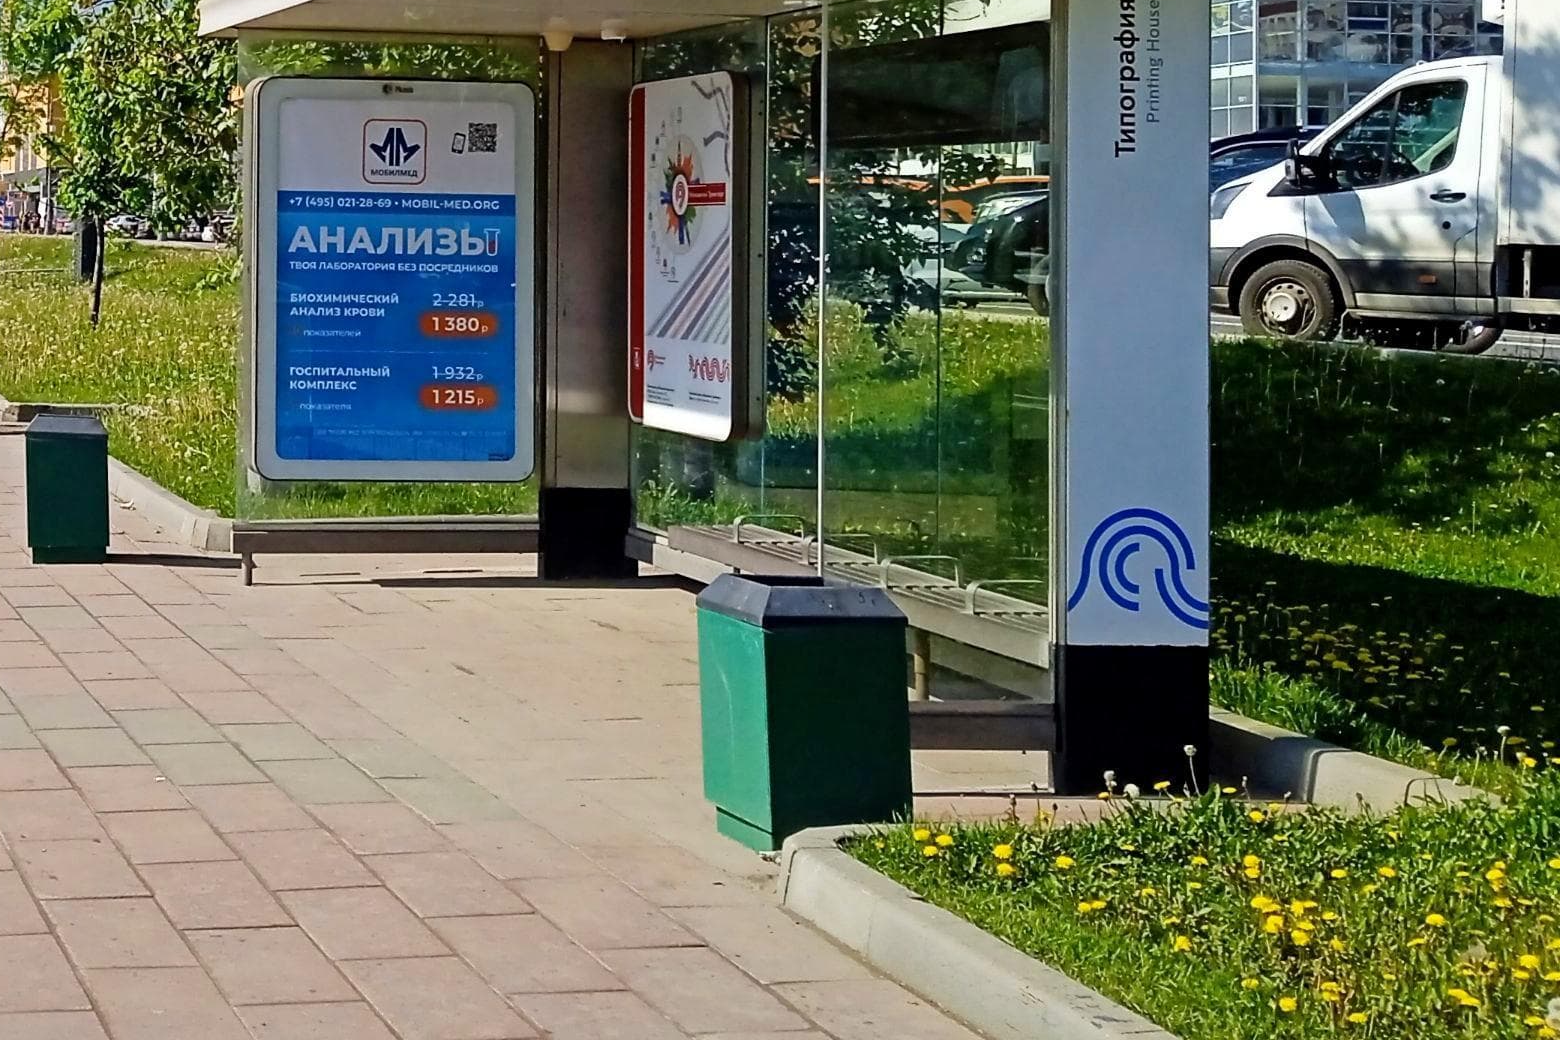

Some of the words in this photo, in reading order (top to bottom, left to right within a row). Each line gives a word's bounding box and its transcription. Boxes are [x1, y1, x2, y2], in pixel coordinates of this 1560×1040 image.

[1146, 0, 1160, 52] House
[1113, 0, 1140, 158] Типография
[1146, 58, 1163, 123] Printing
[370, 168, 418, 178] МОБИЛМЕД
[289, 197, 303, 207] +7
[306, 196, 334, 208] (495)
[337, 197, 391, 208] 021-28-69
[401, 199, 500, 210] MOBIL-MED.ORG
[290, 261, 317, 270] ТВОЯ
[319, 262, 395, 272] ЛАБОРАТОРИЯ
[397, 263, 417, 272] БЕЗ
[419, 263, 499, 274] ПОСРЕДНИКОВ
[290, 292, 399, 304] БИОХИМИЧЕСКИЙ
[290, 307, 340, 317] АНАЛИЗ
[344, 308, 385, 318] КРОВИ
[303, 328, 361, 337] показателей
[290, 365, 390, 378] ГОСПИТАЛЬНЫЙ
[290, 380, 357, 390] КОМПЛЕКС
